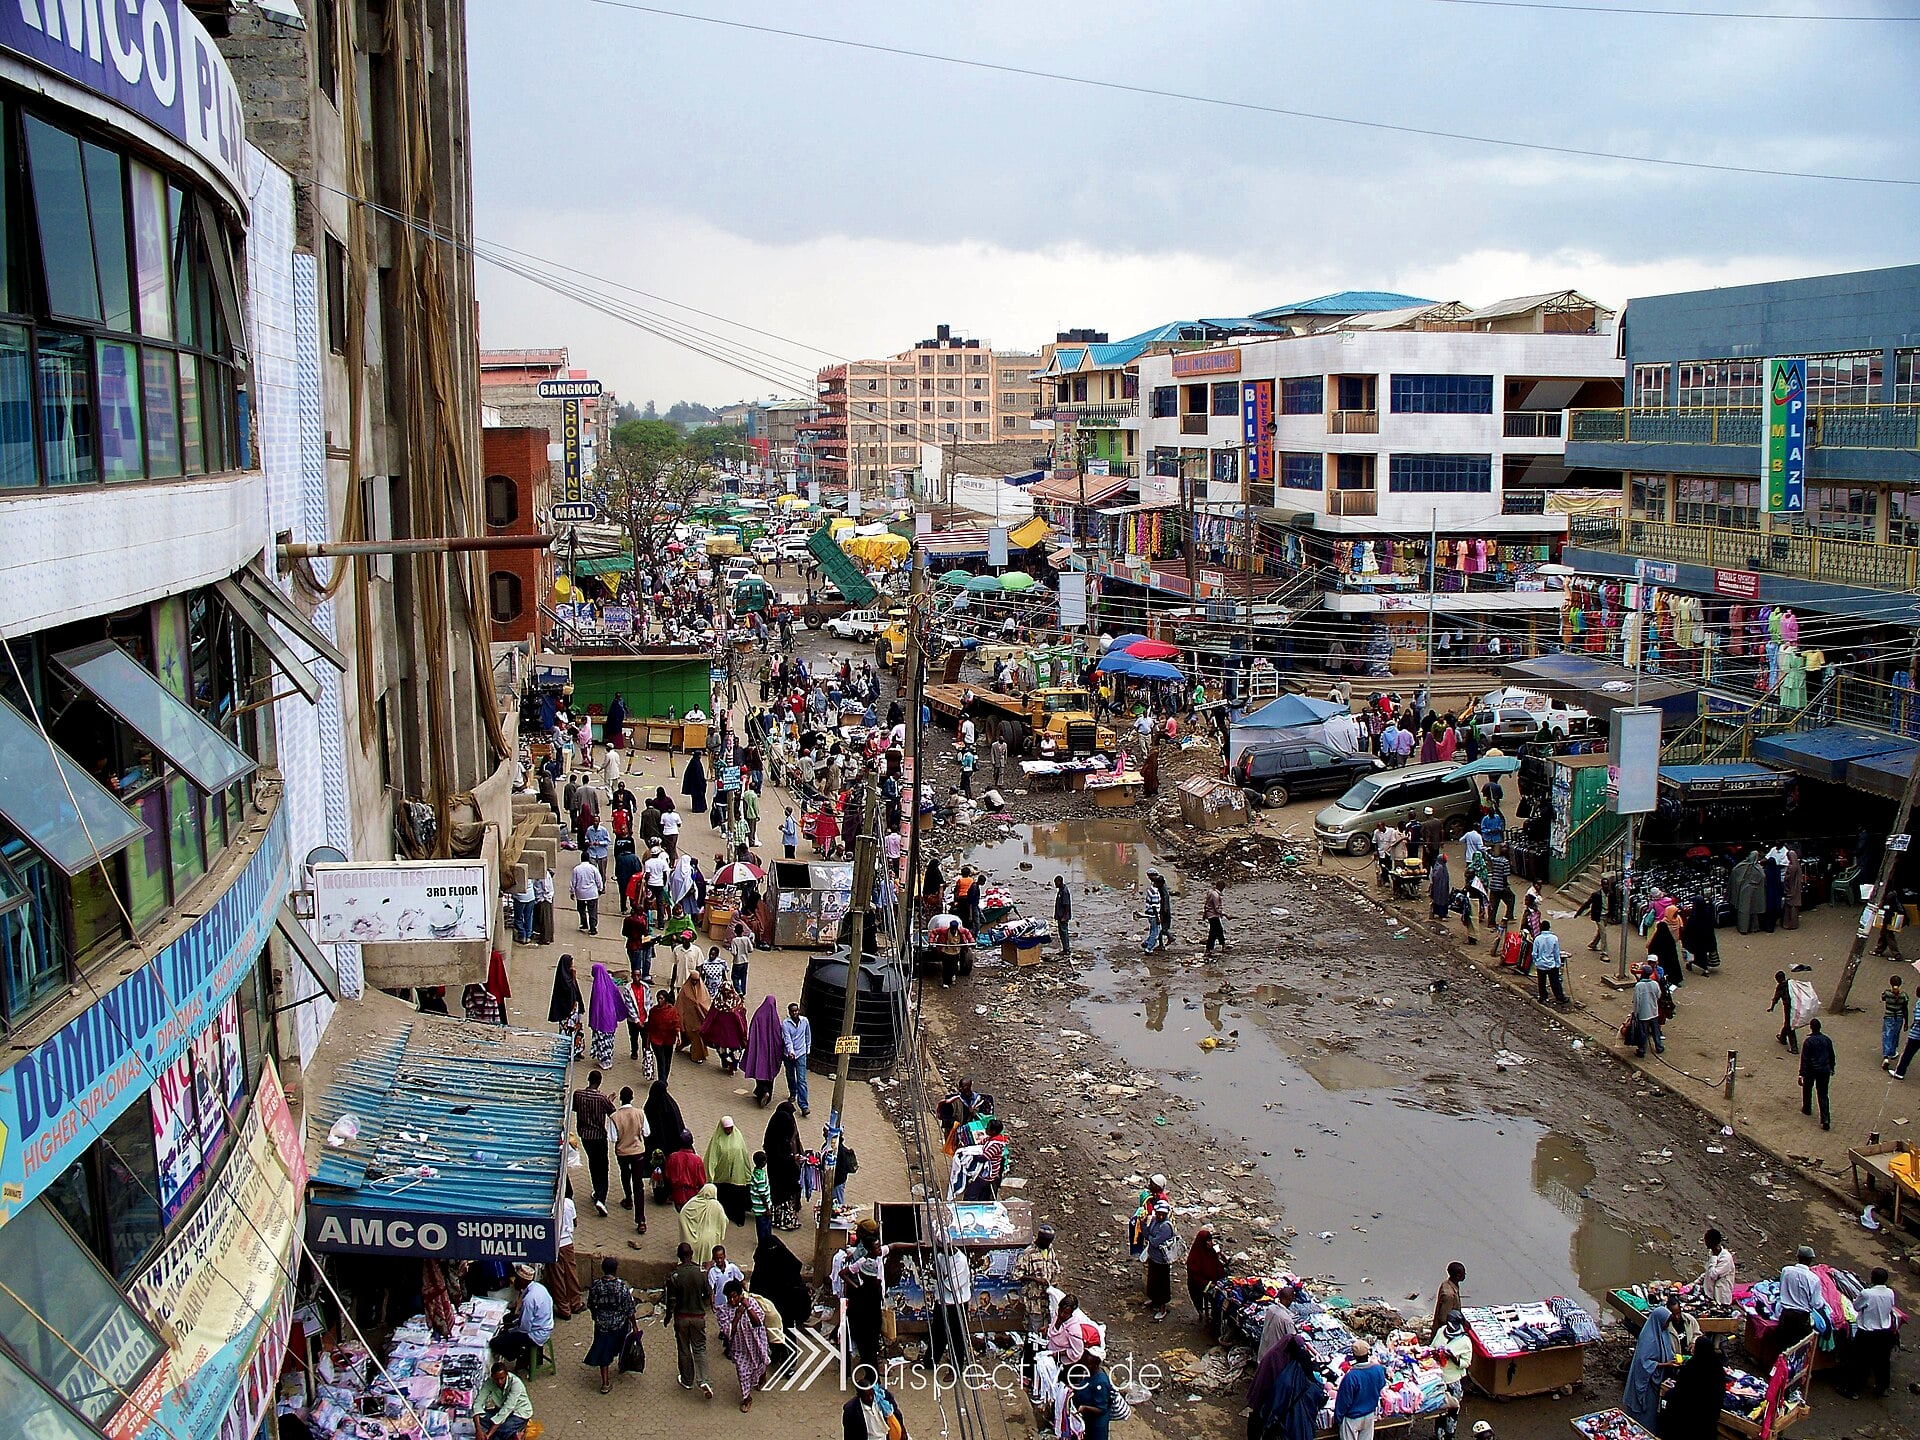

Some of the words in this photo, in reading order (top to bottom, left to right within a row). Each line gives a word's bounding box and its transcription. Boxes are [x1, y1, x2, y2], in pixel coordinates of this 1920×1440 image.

[540, 383, 600, 396] BANGKOK
[1244, 388, 1257, 473] BILAL
[566, 401, 580, 500] SHOPPING
[1788, 401, 1802, 508] PLAZA
[555, 507, 593, 519] MALL
[401, 869, 480, 886] RESTAURANT
[426, 887, 447, 898] 3RD
[449, 886, 478, 897] FLOOR
[13, 953, 166, 1143] DOMINION
[171, 843, 269, 1007] INTERNATIONAL
[22, 1109, 78, 1179] HIGHER
[80, 1050, 142, 1127] DIPLOMAS
[156, 991, 203, 1055] DIPLOMAS
[213, 954, 233, 997] SHORT
[152, 1049, 177, 1080] Your
[317, 1216, 448, 1251] AMCO
[457, 1221, 546, 1240] SHOPPING
[480, 1239, 528, 1257] MALL
[171, 1281, 205, 1346] PRIMARY
[188, 1401, 213, 1438] Business
